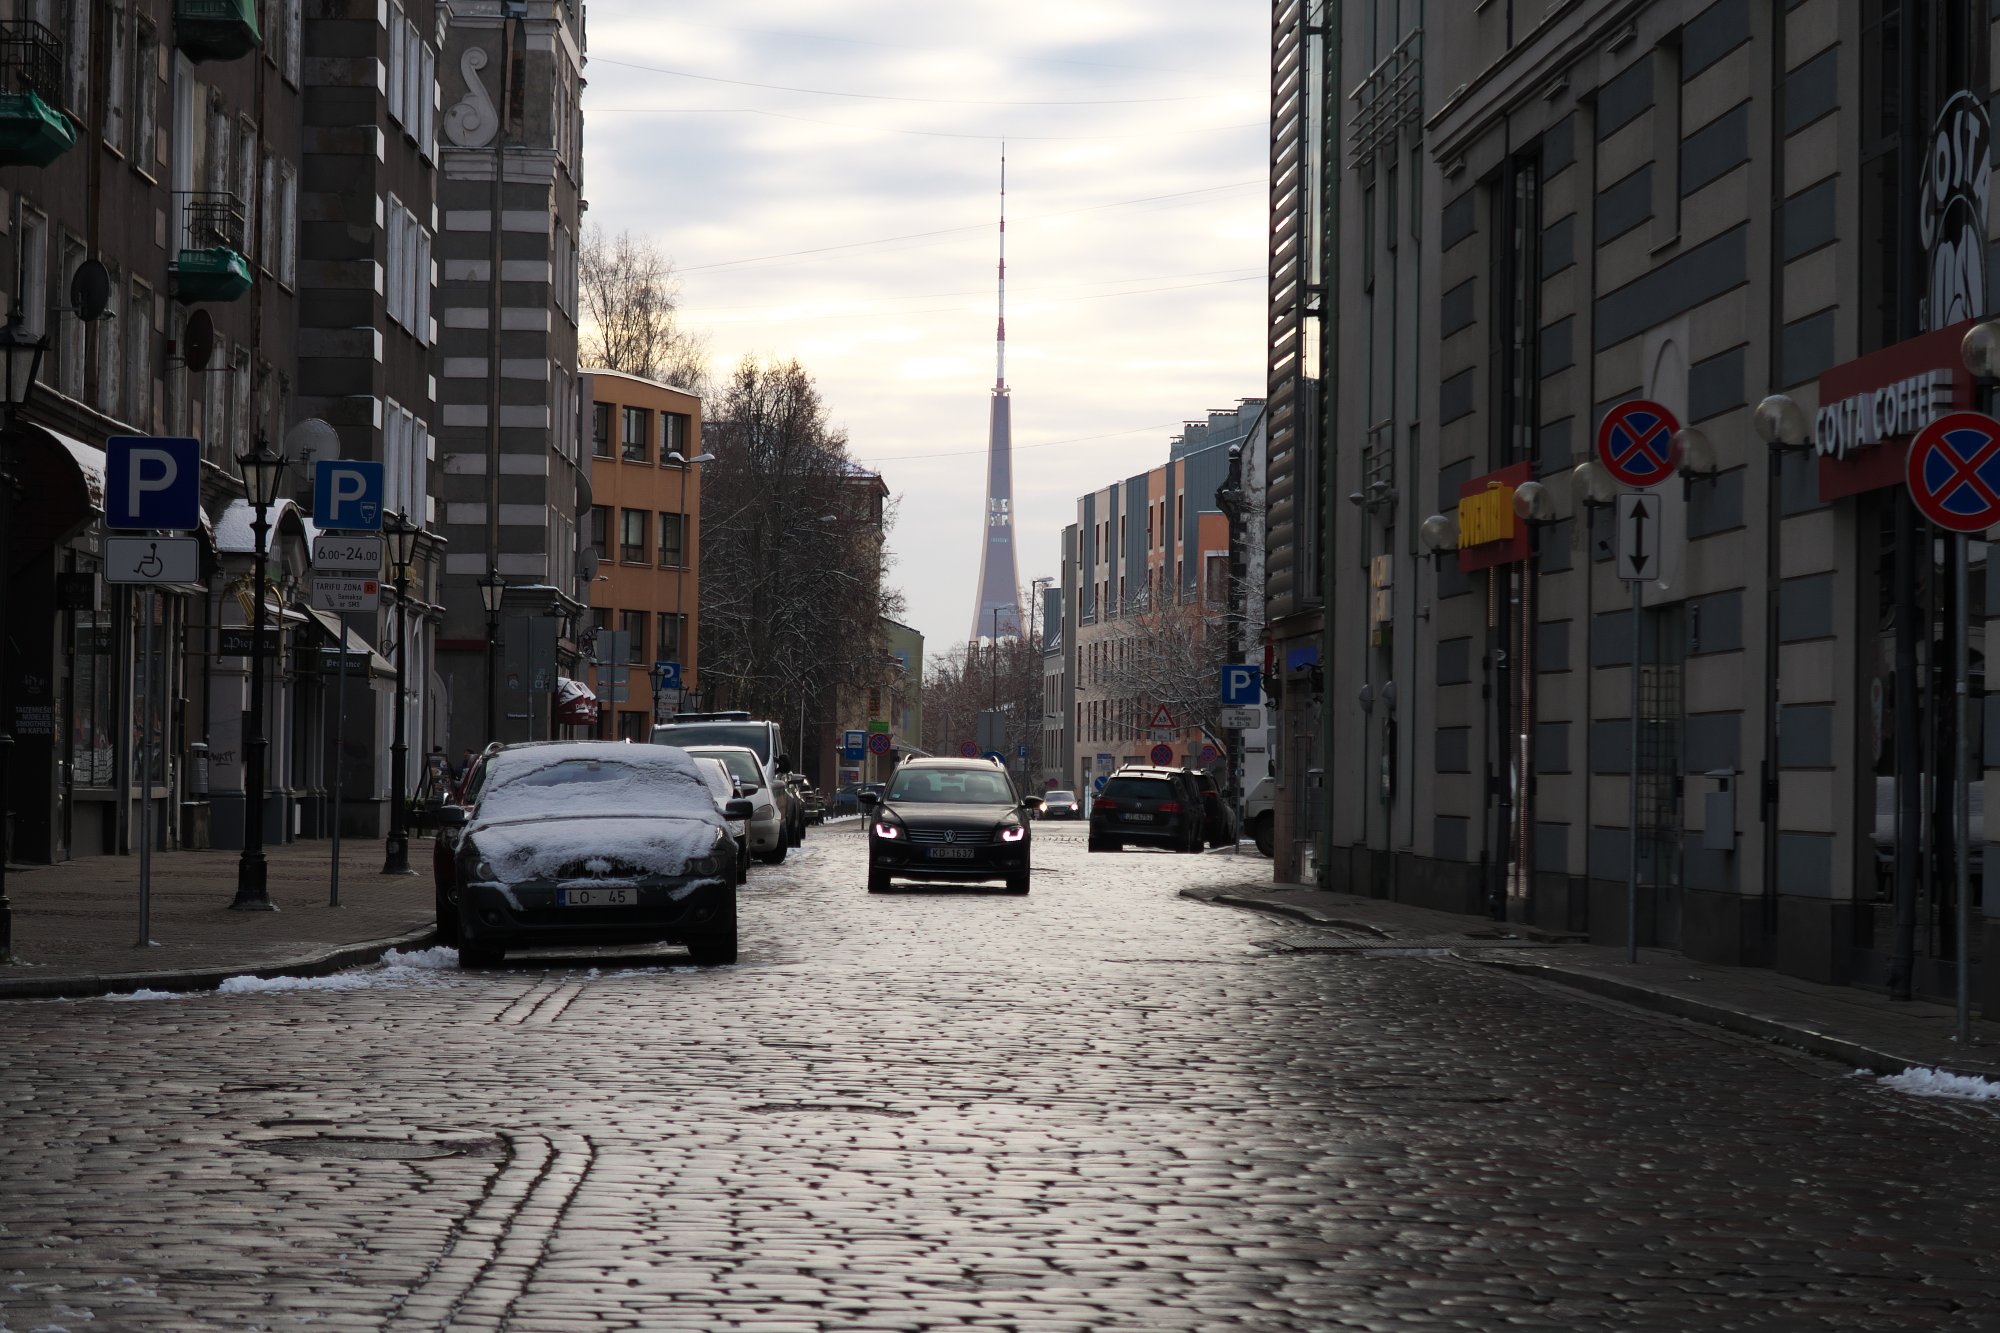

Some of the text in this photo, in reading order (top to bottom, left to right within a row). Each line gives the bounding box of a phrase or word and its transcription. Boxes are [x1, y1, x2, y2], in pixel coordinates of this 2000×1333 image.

[1920, 110, 1991, 250] COSTA
[1815, 369, 1952, 461] COSTA COFFEE
[128, 448, 178, 517] P
[329, 469, 368, 520] P
[317, 546, 378, 561] 6.00-24.00
[343, 583, 362, 592] ZONA
[1230, 670, 1252, 700] P
[932, 848, 973, 858] KD-1637
[608, 890, 626, 903] 45
